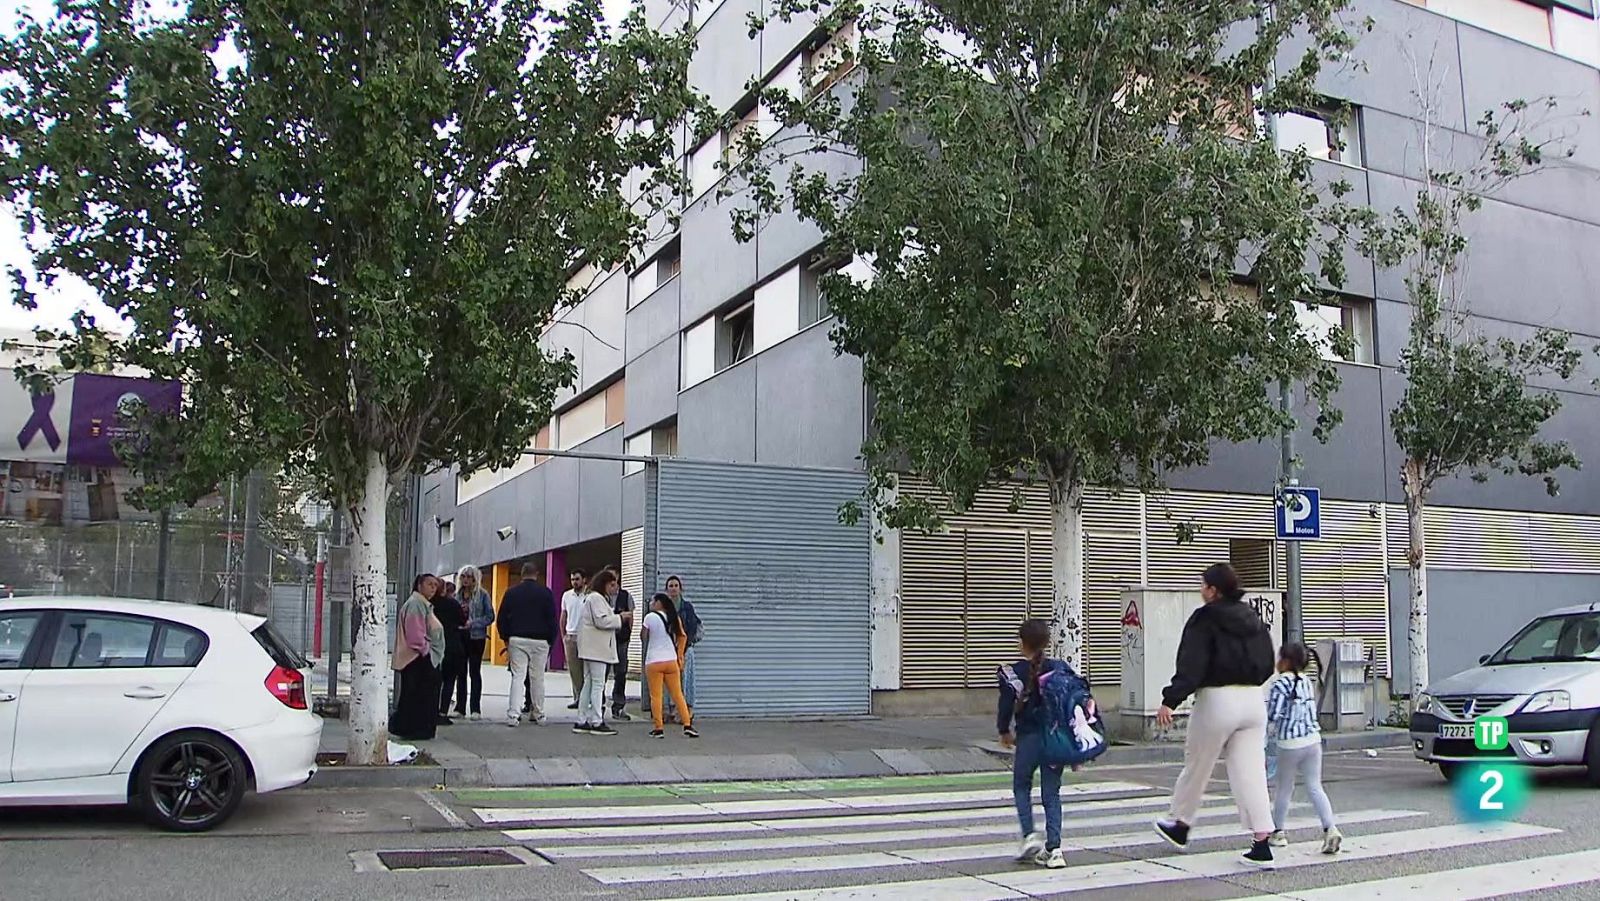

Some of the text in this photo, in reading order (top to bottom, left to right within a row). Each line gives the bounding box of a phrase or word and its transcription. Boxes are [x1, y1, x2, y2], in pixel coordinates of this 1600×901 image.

[1285, 493, 1311, 533] P
[1444, 726, 1474, 737] 7272 F
